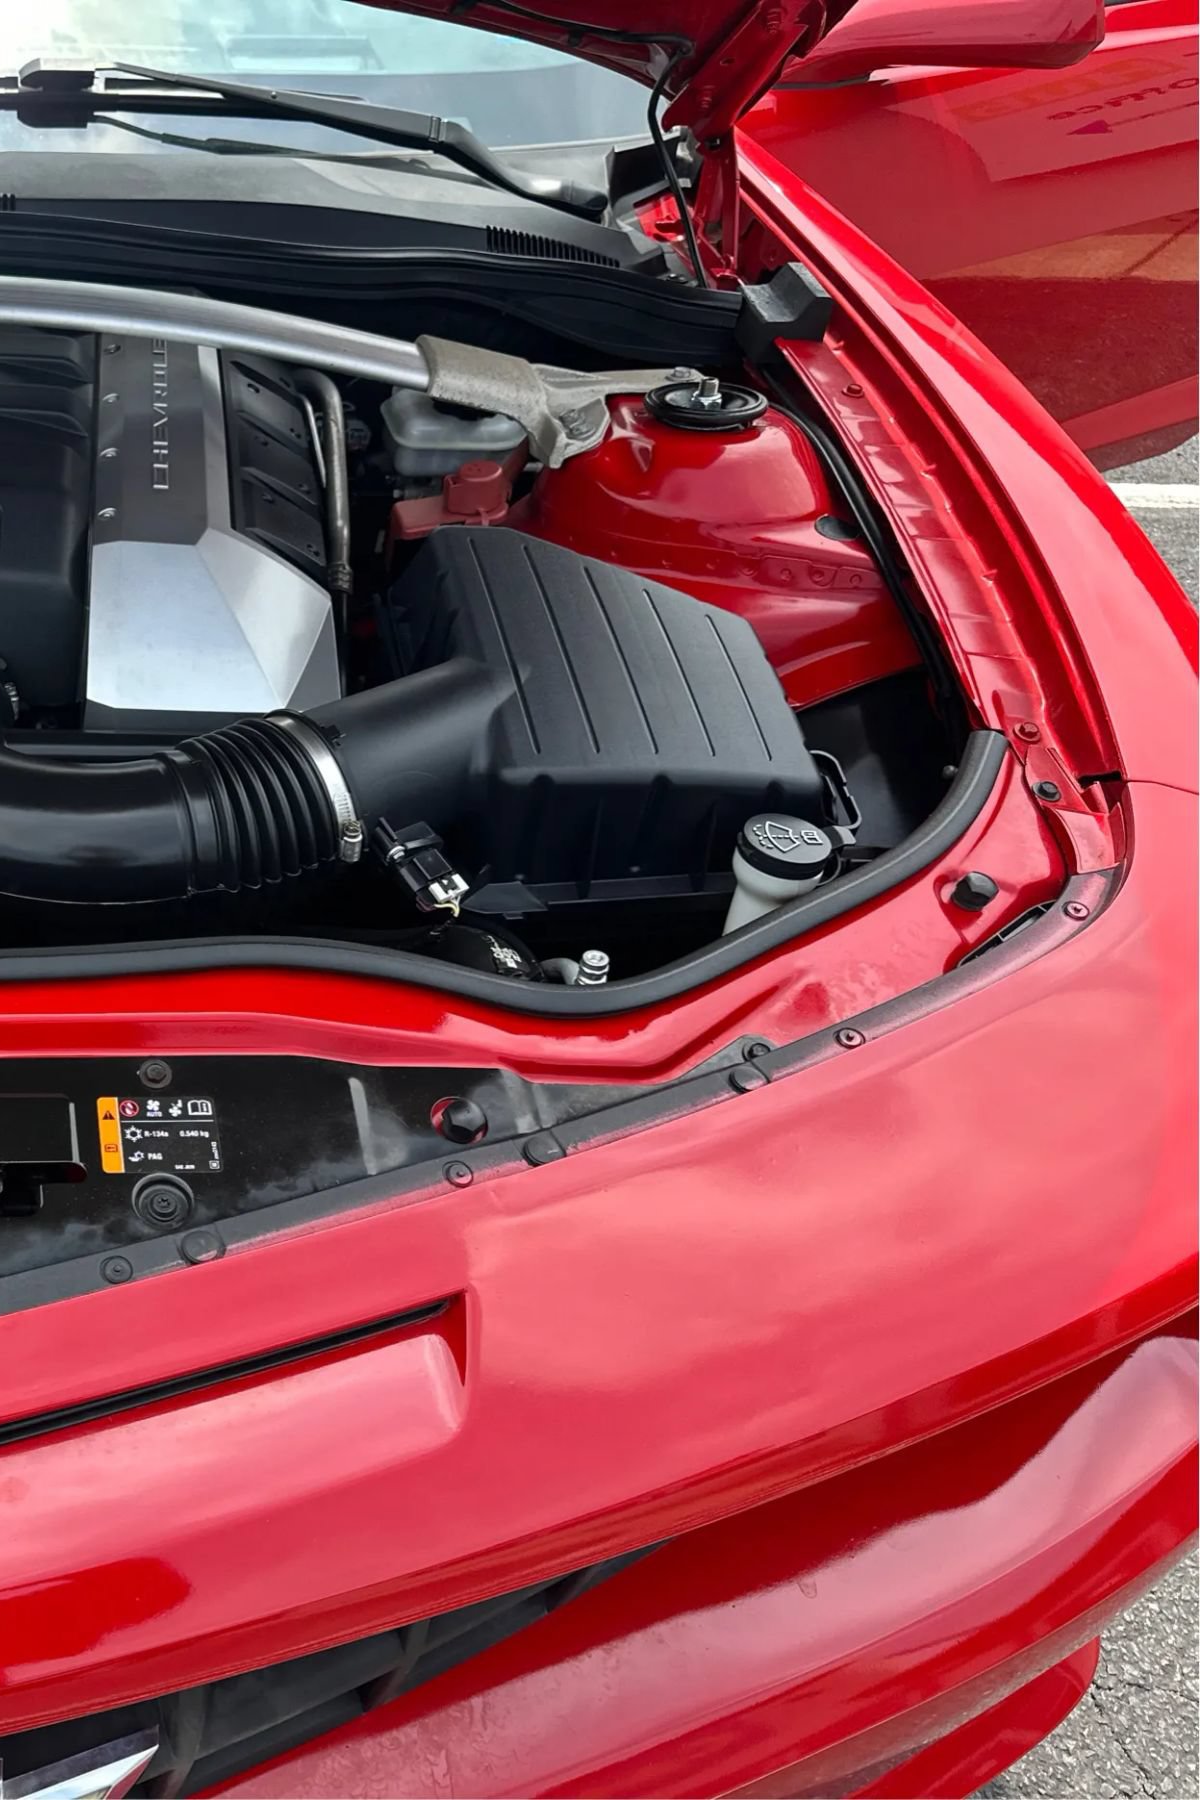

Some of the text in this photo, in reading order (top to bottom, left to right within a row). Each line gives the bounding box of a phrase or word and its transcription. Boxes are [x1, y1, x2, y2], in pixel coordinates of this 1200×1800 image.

[152, 338, 169, 489] CHEVROLE
[199, 1130, 210, 1138] kg
[147, 1152, 163, 1160] PAG
